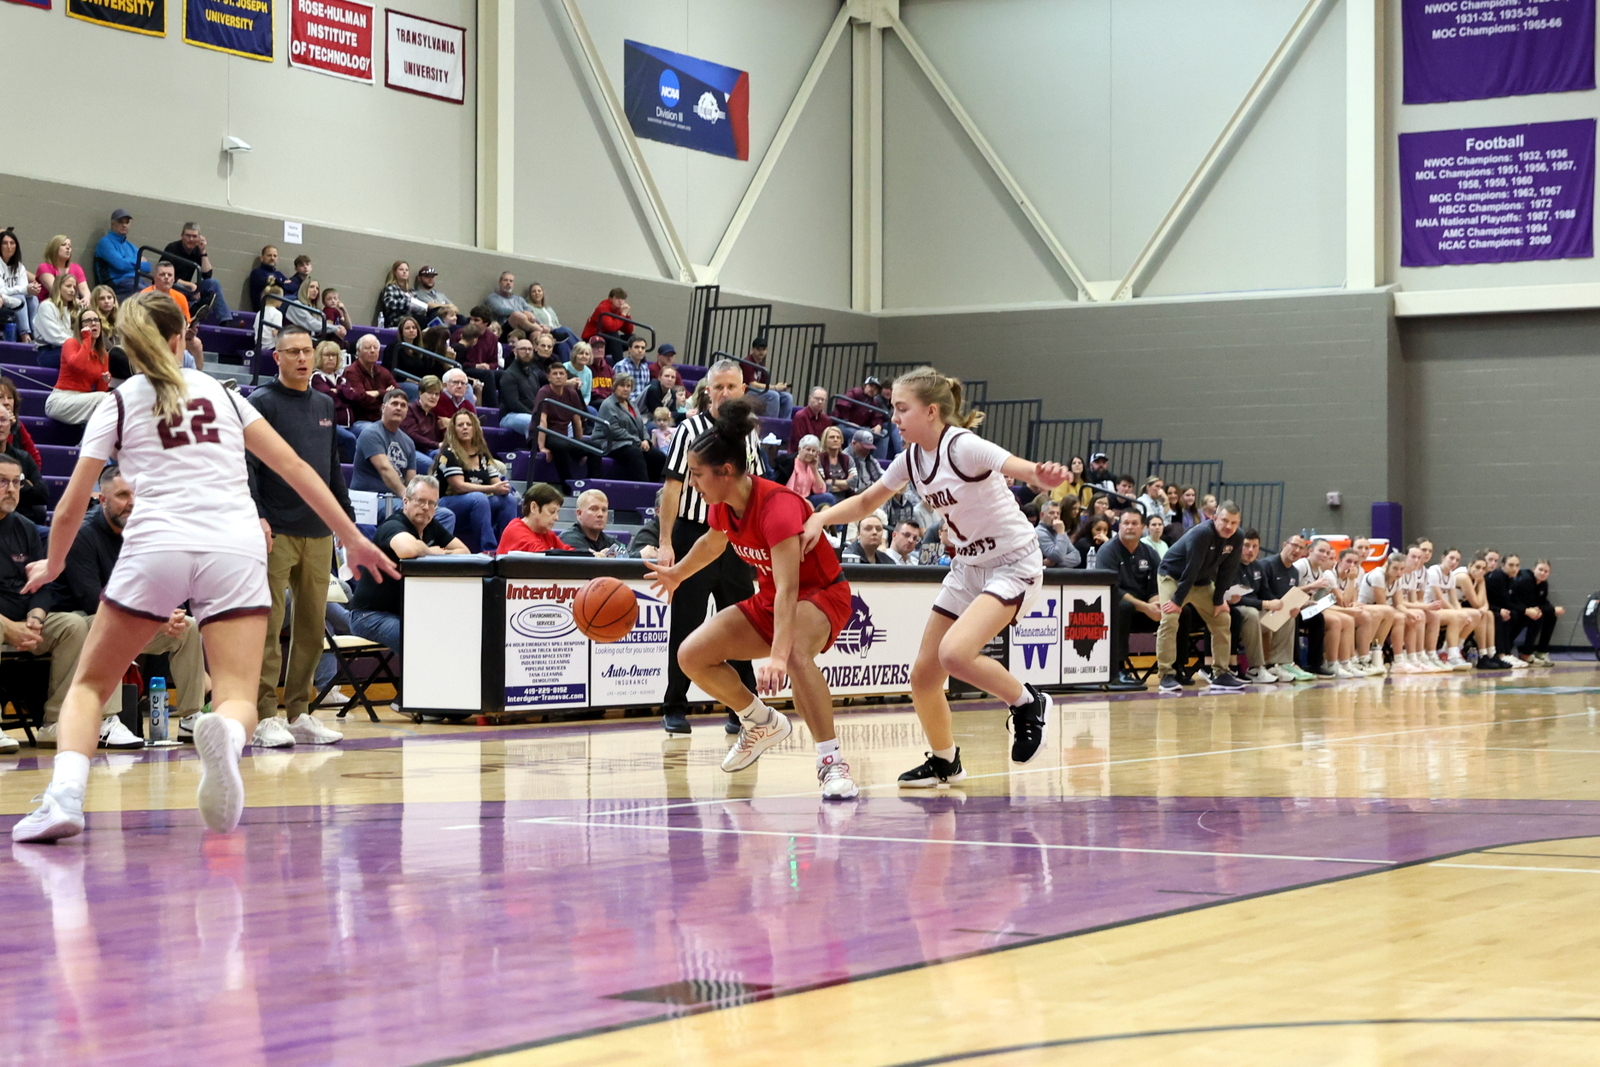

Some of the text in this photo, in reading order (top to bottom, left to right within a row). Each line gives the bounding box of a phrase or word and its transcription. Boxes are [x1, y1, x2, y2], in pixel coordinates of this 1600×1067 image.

[82, 0, 154, 17] ERSITY
[236, 0, 268, 13] JOSEPH
[1425, 0, 1521, 14] NWOC Champions:
[205, 9, 254, 31] UNIVERSITY
[1455, 12, 1496, 24] 1931-32,
[307, 22, 358, 47] INSTITUTE
[1432, 28, 1457, 40] MOC
[1459, 22, 1520, 37] Champions:
[396, 28, 456, 55] TRANSYLVANIA
[292, 40, 371, 71] OF TECHNOLOGY
[404, 60, 449, 83] UNIVERSITY
[661, 86, 680, 100] NCAA
[656, 106, 677, 121] Division
[1466, 134, 1525, 151] Football
[1424, 157, 1454, 168] NWOC
[1457, 153, 1513, 166] Champions:
[1518, 151, 1543, 162] 1932,
[1415, 169, 1437, 180] MOL
[1439, 166, 1495, 178] Champions:
[1497, 165, 1522, 175] 1951,
[1429, 193, 1452, 203] MOC
[1454, 190, 1510, 202] Champions:
[1438, 199, 1552, 214] HBCC Champions: 1972
[1415, 219, 1439, 228] NAIA
[1440, 215, 1479, 226] National
[1480, 213, 1522, 225] Playoffs:
[1442, 228, 1465, 238] AMC
[1467, 226, 1523, 237] Champions:
[1438, 240, 1466, 250] HCAC
[1468, 237, 1524, 248] Champions:
[153, 398, 221, 450] 22
[506, 584, 581, 603] Interdyn
[635, 605, 668, 628] LLY
[1069, 612, 1105, 626] FARMERS
[643, 632, 668, 642] GROUP
[1014, 624, 1057, 637] Wannemacher
[1064, 626, 1108, 640] EQUIPMENT
[595, 646, 615, 656] Looking
[625, 645, 633, 654] for
[633, 647, 642, 655] you
[601, 664, 661, 678] Auto-Owners
[818, 663, 911, 688] ONBEAVERS.
[507, 693, 584, 703] Interdyne-Transvac.com
